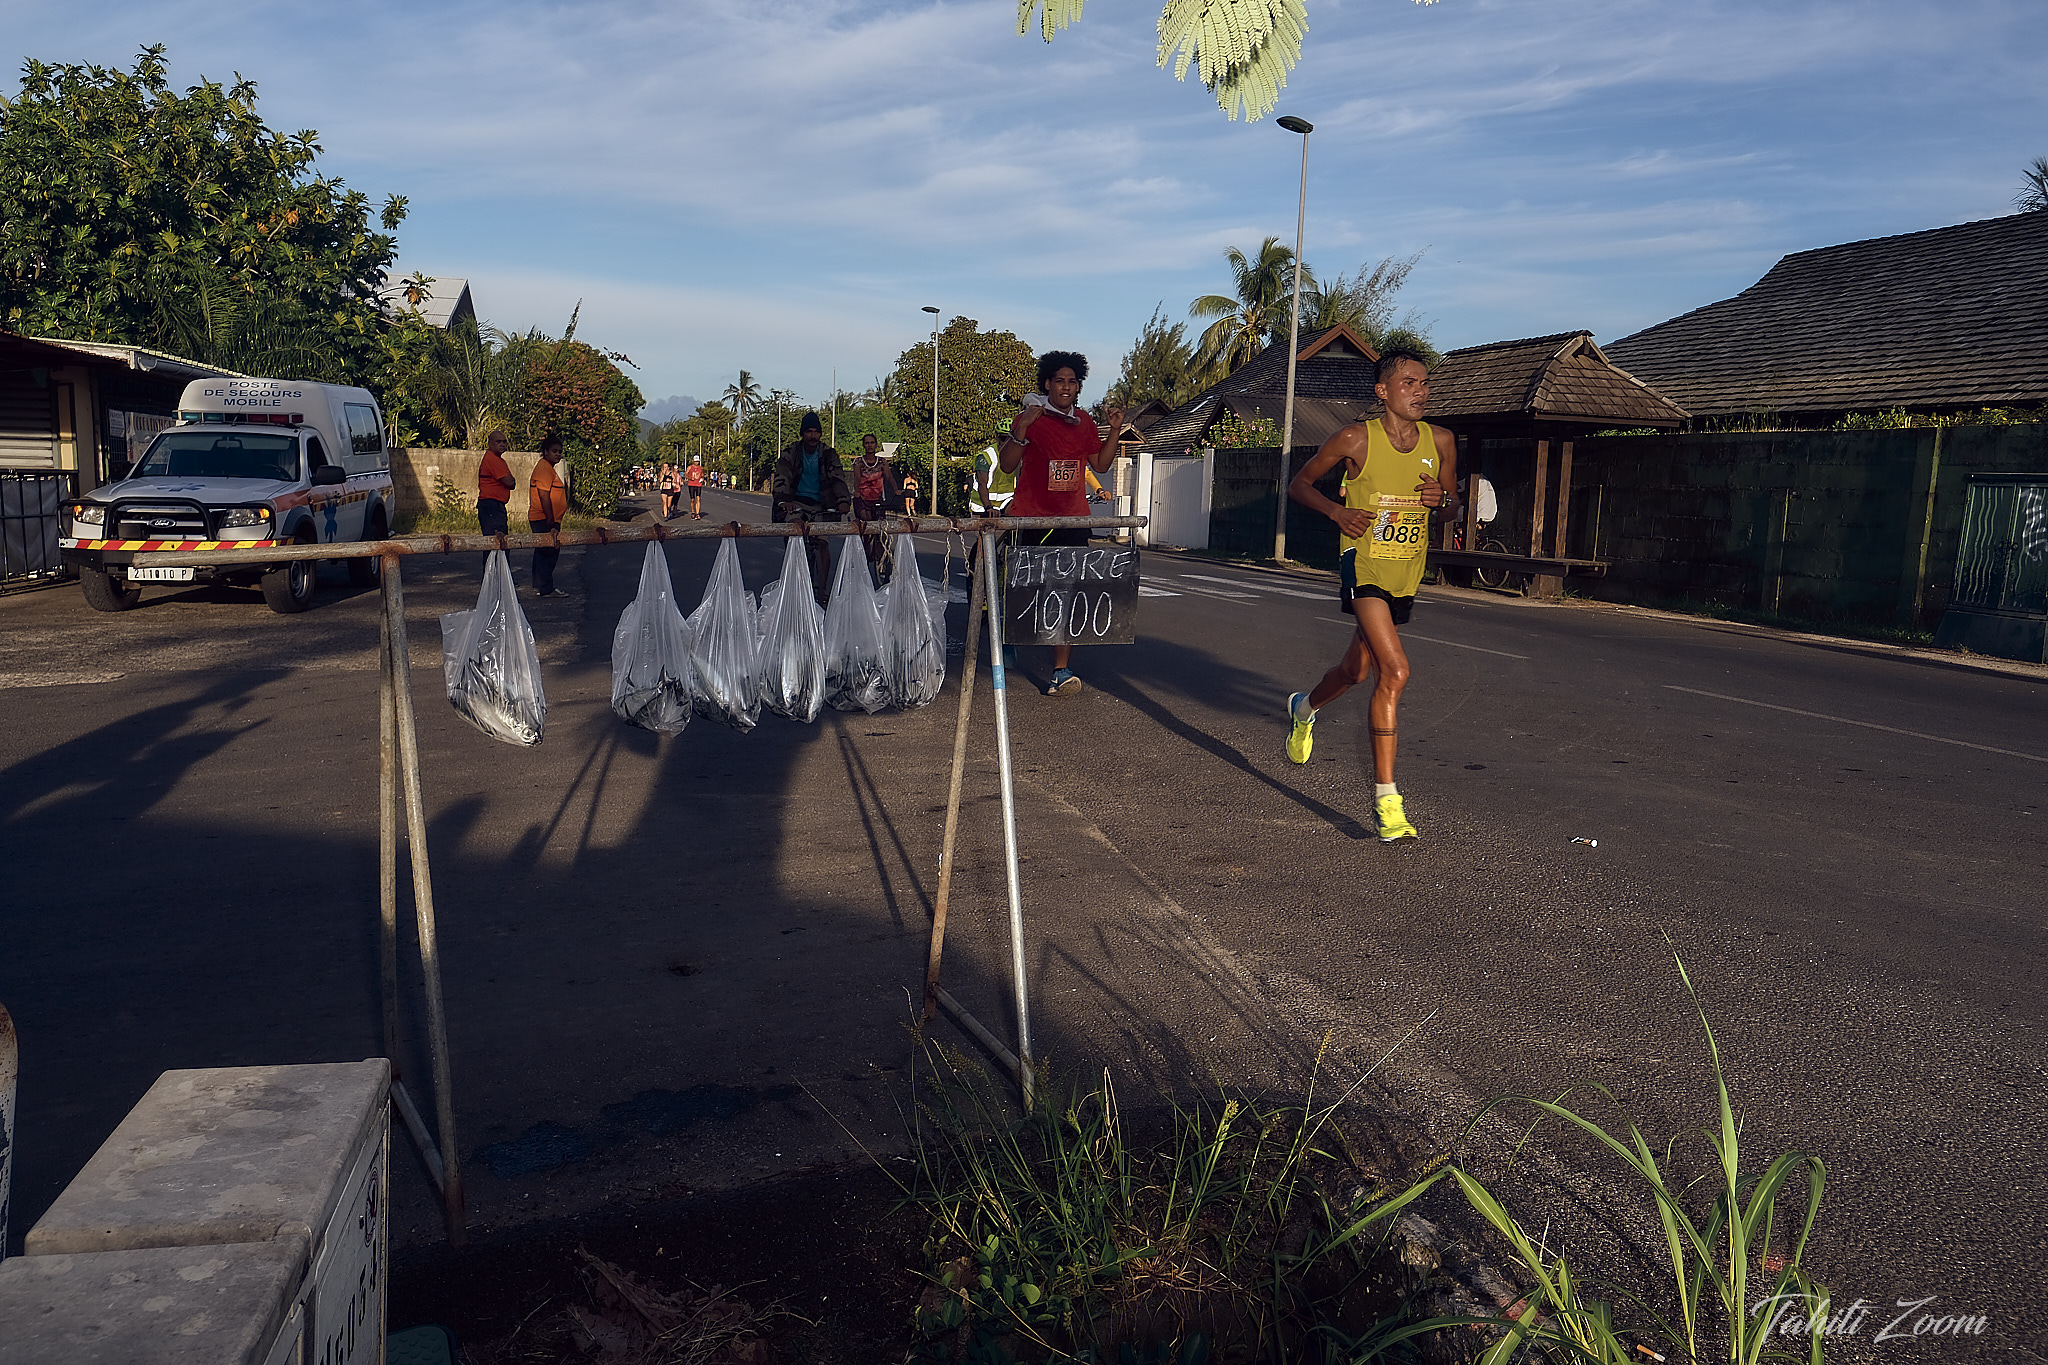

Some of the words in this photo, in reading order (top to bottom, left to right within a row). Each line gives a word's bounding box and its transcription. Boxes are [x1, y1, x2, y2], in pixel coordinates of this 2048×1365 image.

[229, 381, 280, 389] POSTE
[204, 389, 225, 397] DE
[228, 389, 302, 398] SECOURS
[223, 398, 282, 407] MOBILE
[1055, 469, 1076, 481] 867
[1383, 525, 1421, 544] 088
[182, 569, 187, 579] P
[1010, 549, 1132, 588] ATURE
[1017, 589, 1112, 637] 1000
